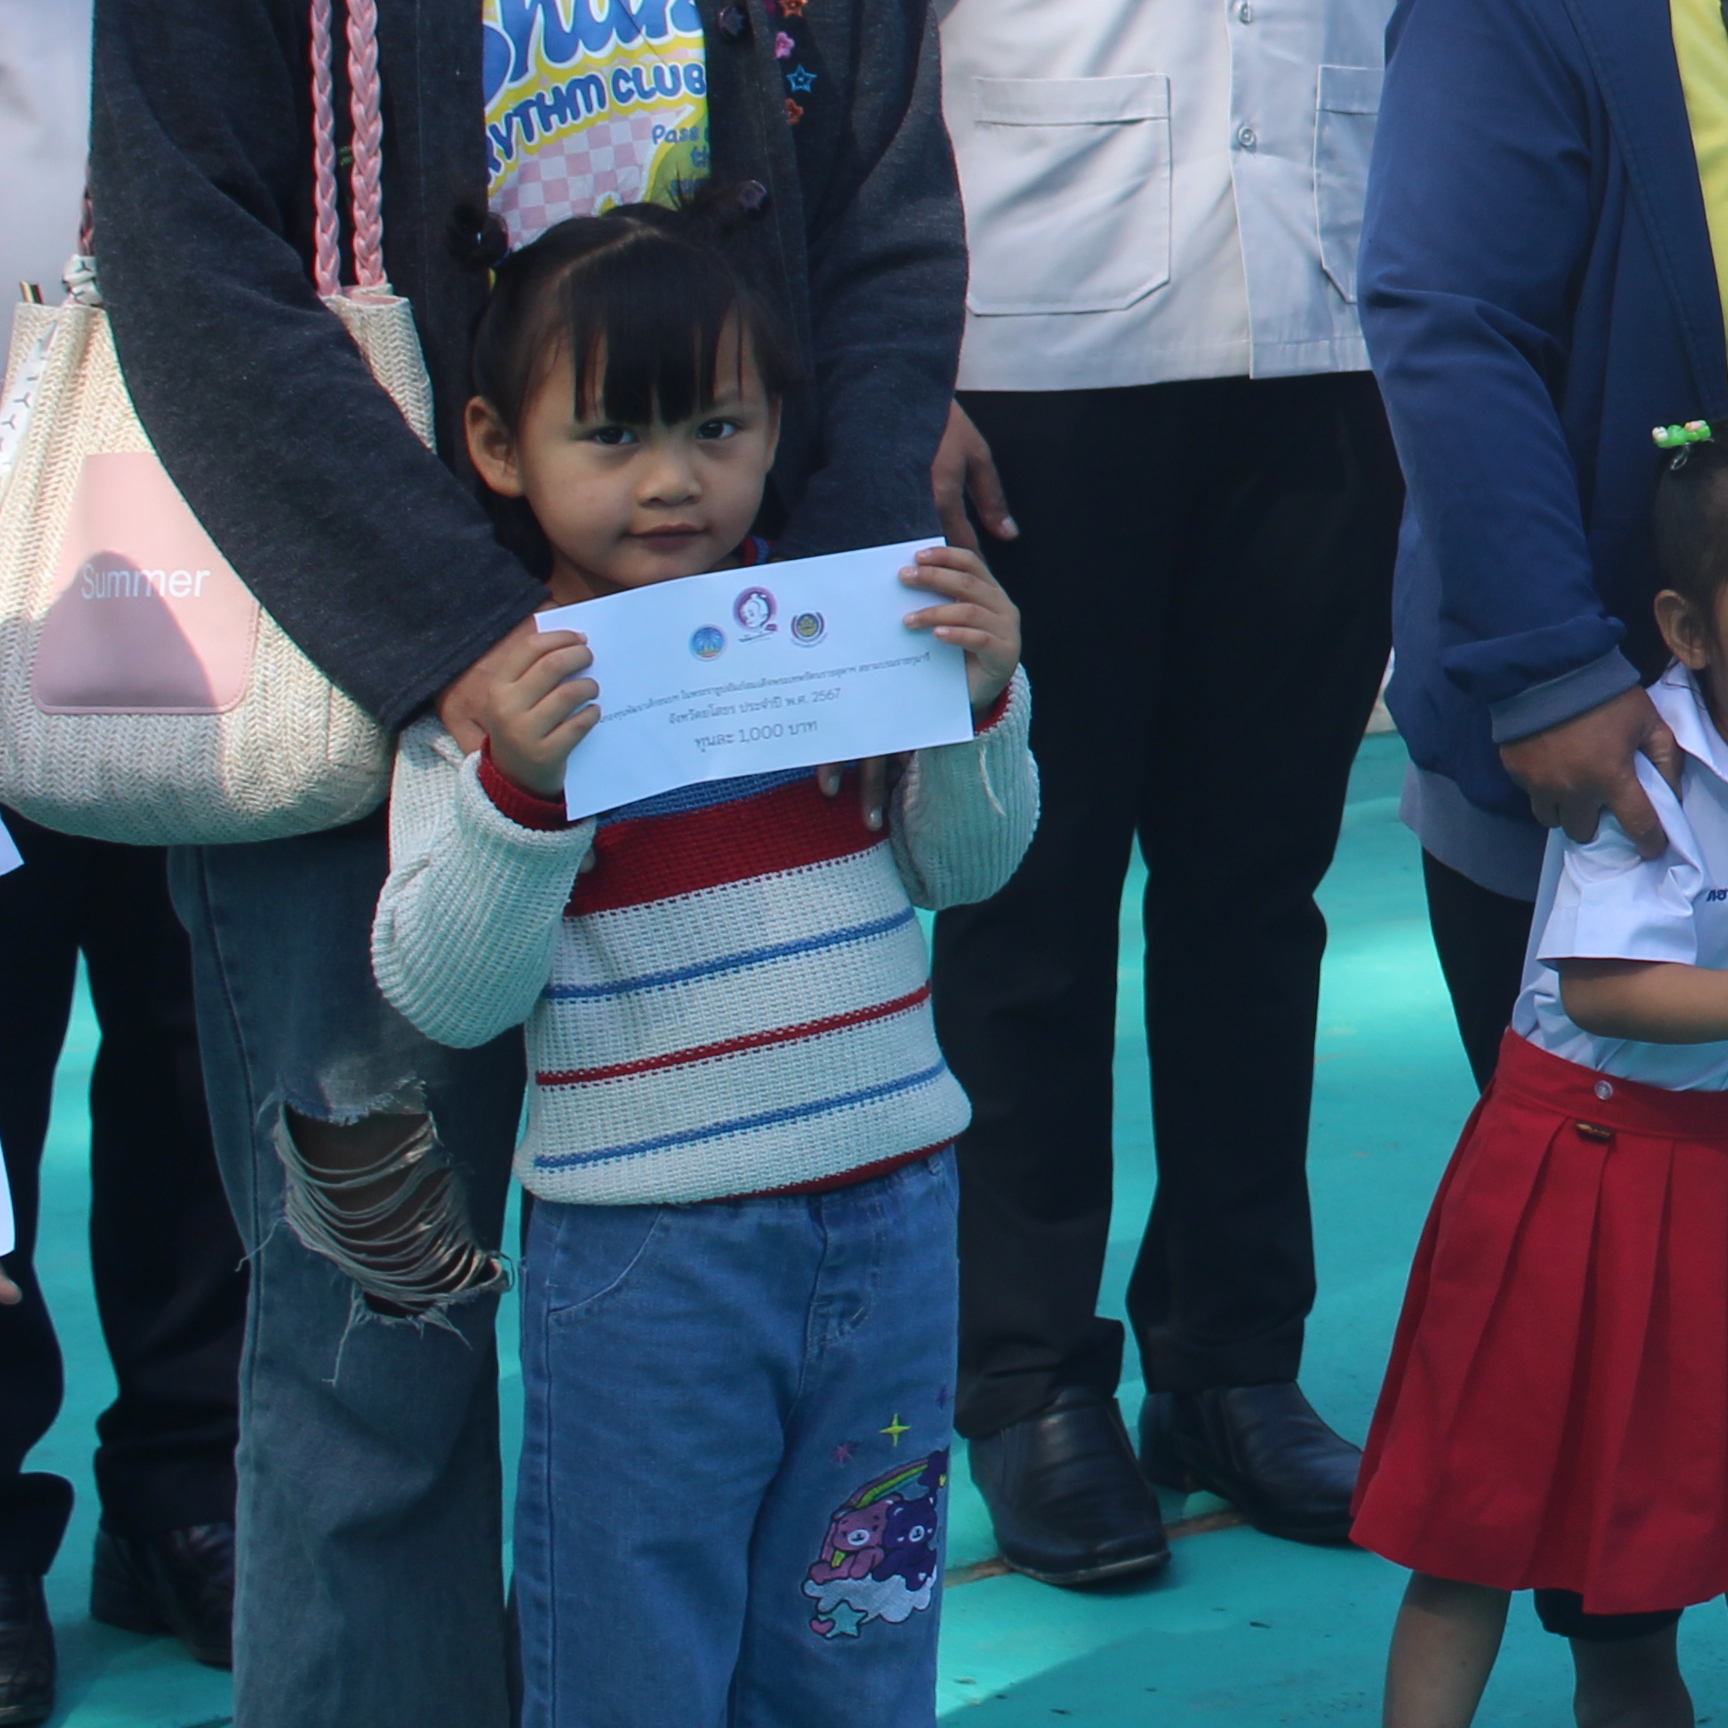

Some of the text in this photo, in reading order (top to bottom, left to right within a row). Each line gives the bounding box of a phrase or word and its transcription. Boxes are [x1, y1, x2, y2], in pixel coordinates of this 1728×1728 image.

[611, 63, 707, 104] CLUB
[652, 124, 699, 145] Pass
[81, 562, 211, 600] Summer
[812, 687, 842, 704] 2567
[694, 731, 735, 753] ทุนละ
[788, 719, 819, 736] บาท
